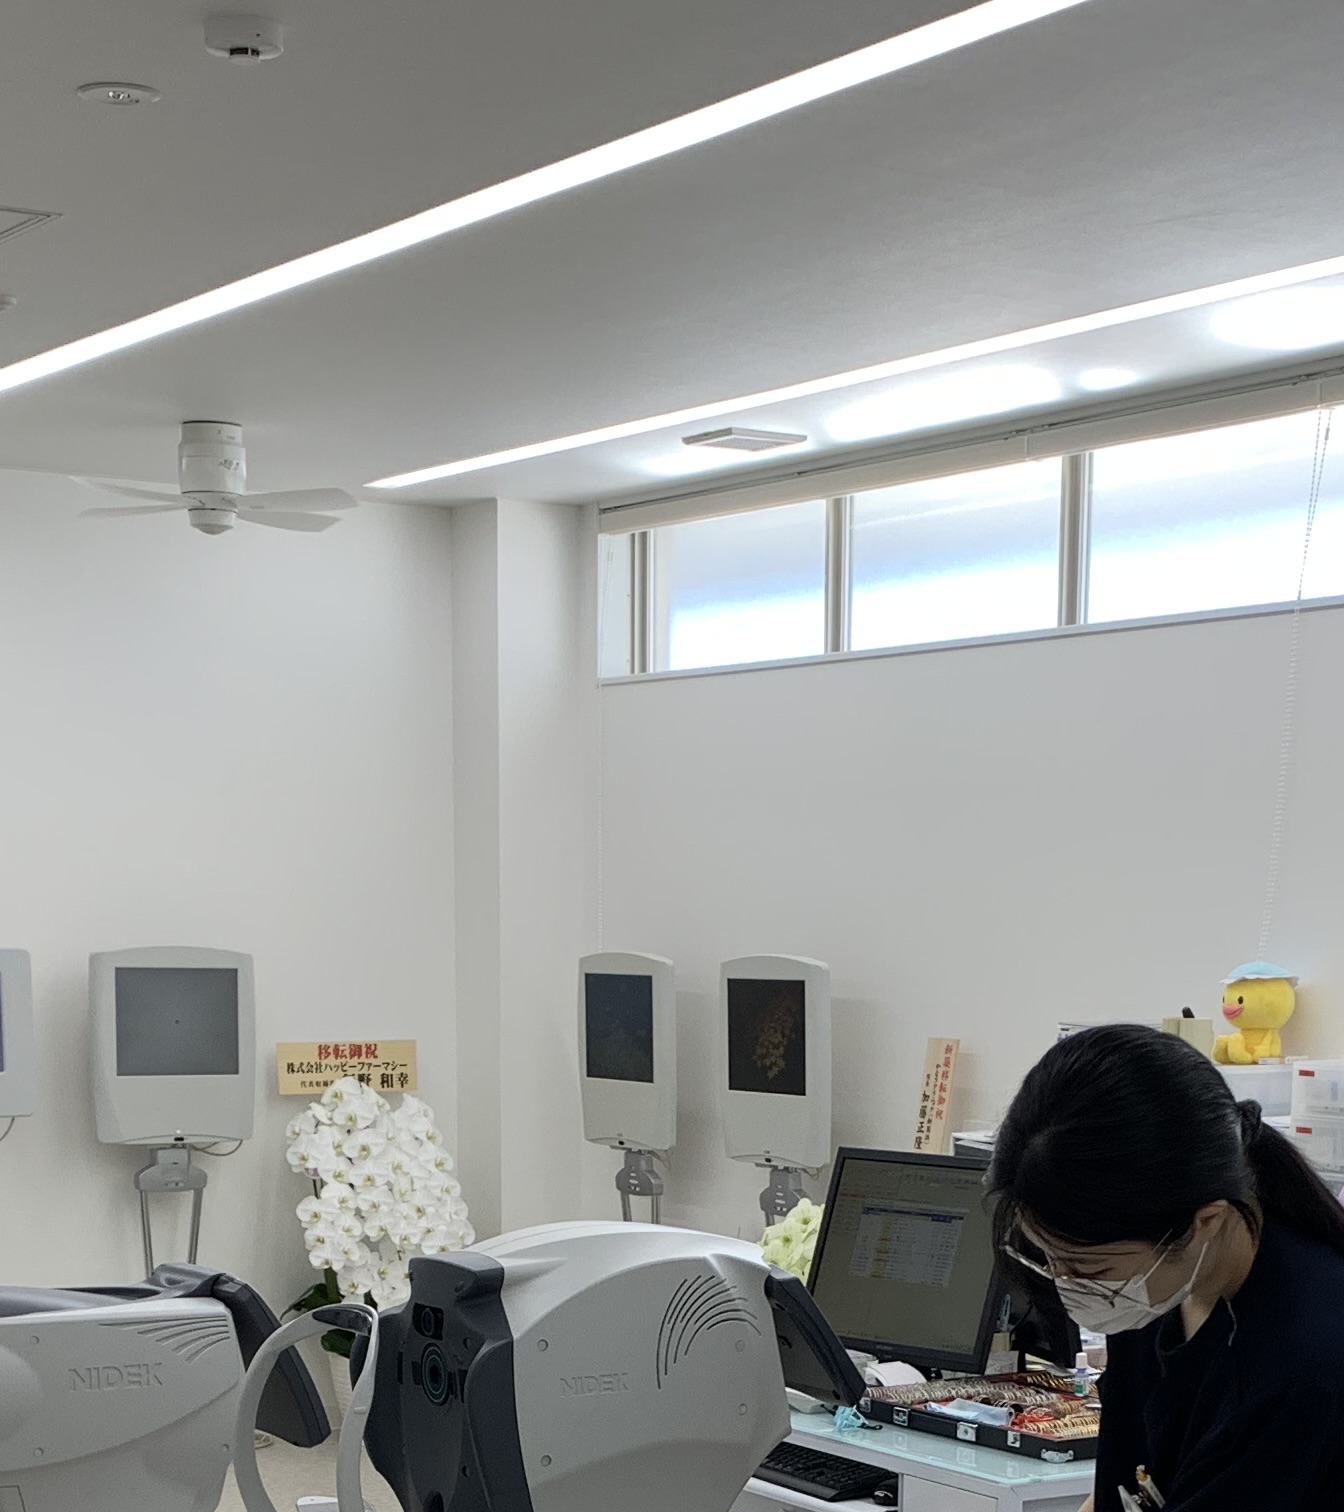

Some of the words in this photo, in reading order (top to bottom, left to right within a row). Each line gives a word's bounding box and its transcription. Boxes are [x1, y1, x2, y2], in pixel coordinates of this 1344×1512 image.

[317, 1043, 378, 1060] 移転御祝
[286, 1061, 408, 1074] 株式会社ハッピーファーマシー
[380, 1072, 409, 1089] 和幸
[67, 1362, 163, 1391] NIDEK
[559, 1372, 630, 1397] NIDEK
